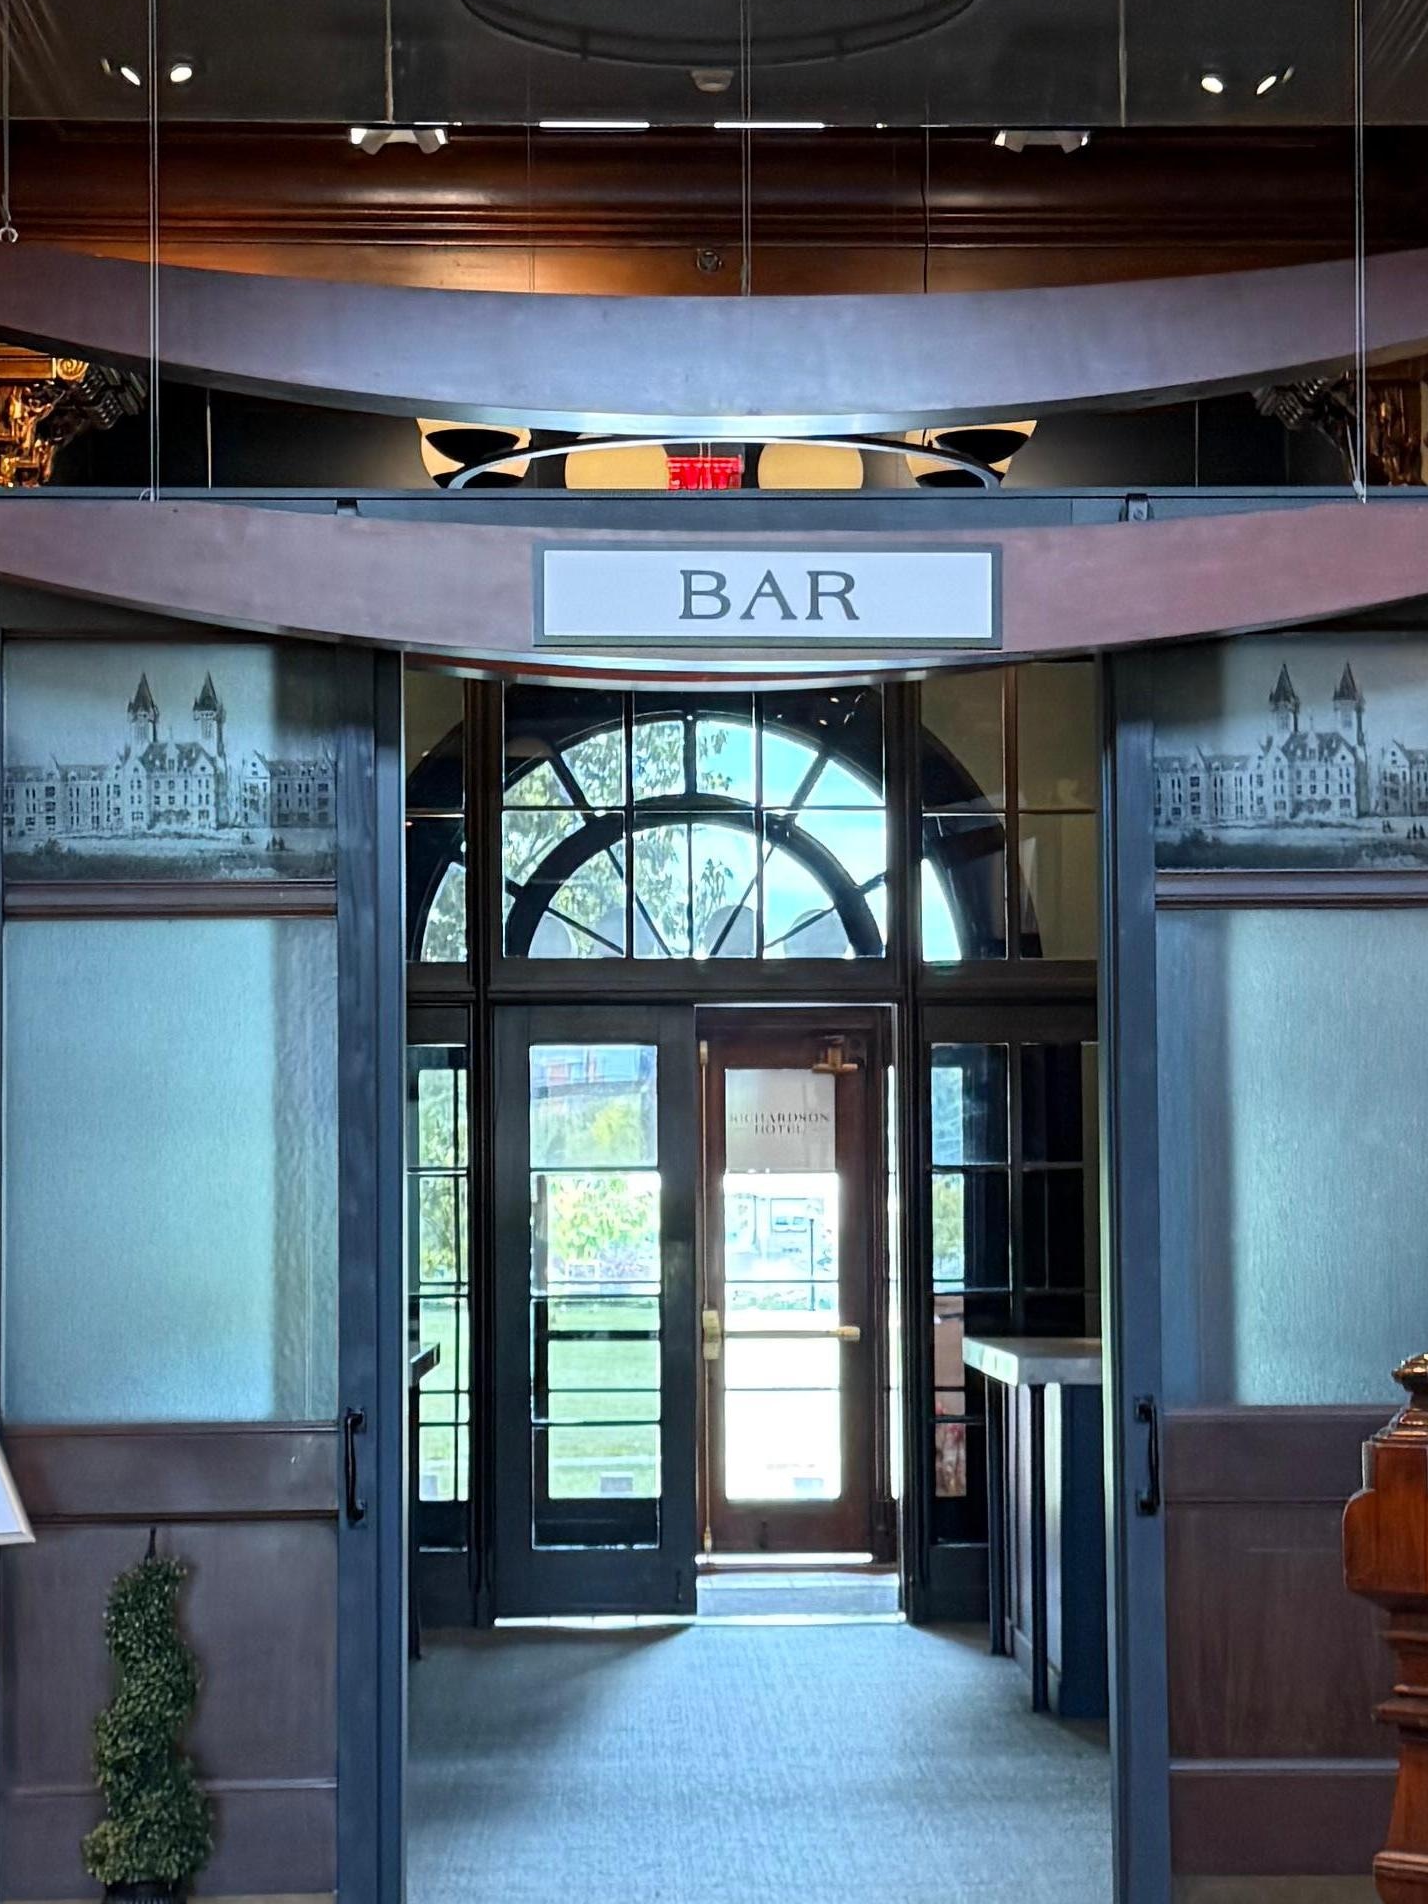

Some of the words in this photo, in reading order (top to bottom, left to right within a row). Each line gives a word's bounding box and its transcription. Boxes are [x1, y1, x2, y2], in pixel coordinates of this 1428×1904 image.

[678, 569, 860, 621] BAR
[729, 1111, 830, 1123] RICHARDSON
[754, 1123, 807, 1135] HOTEL
